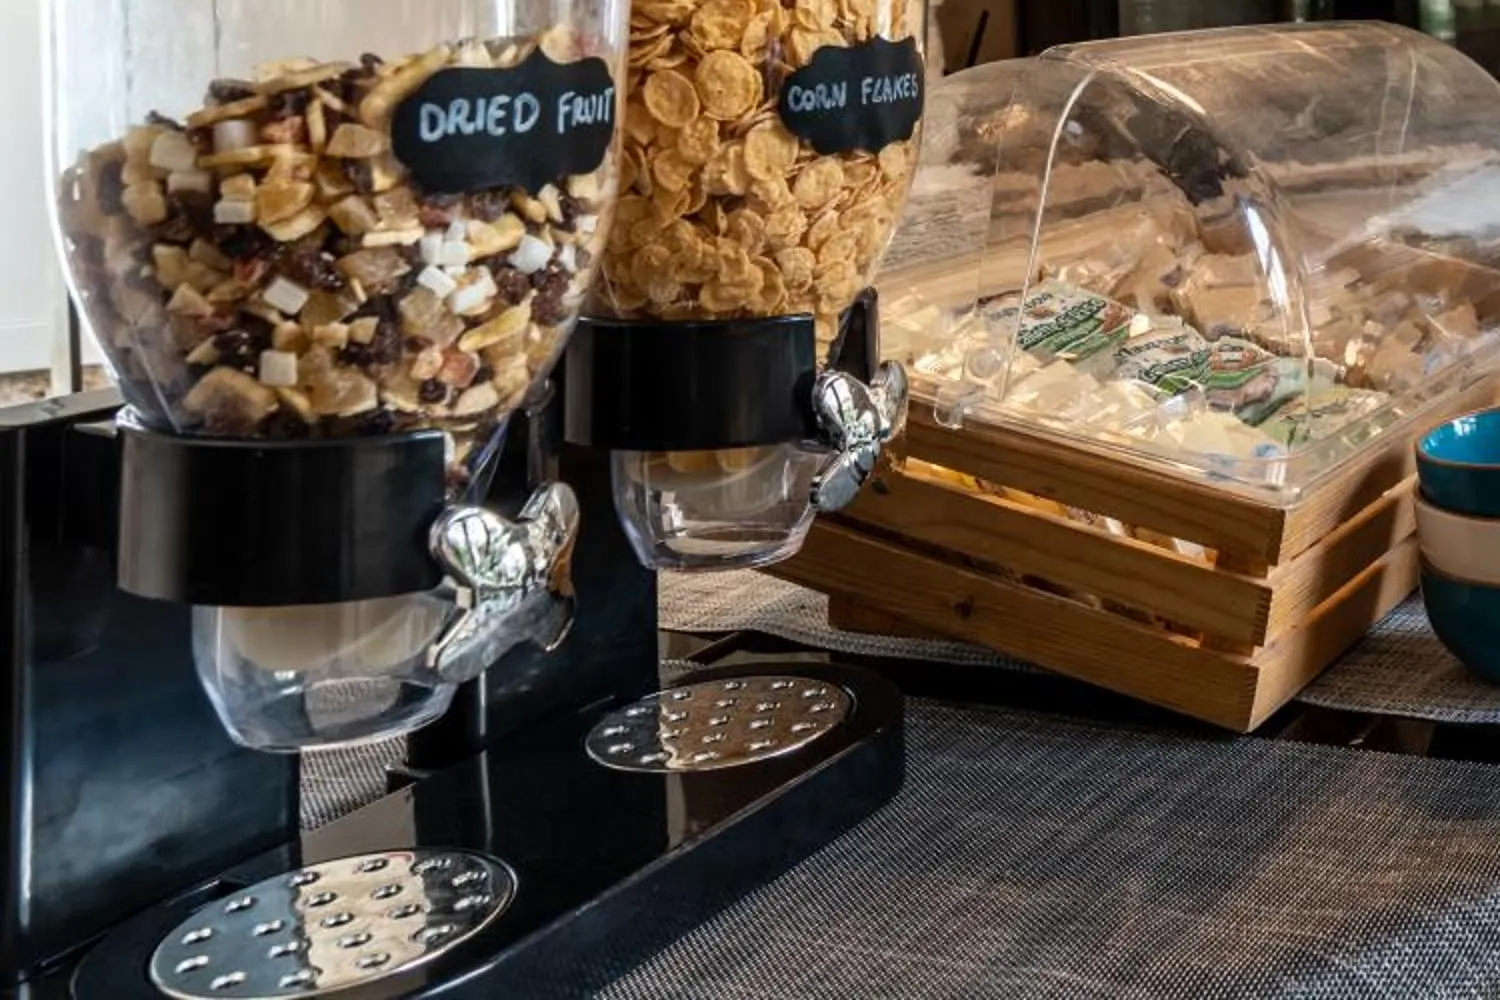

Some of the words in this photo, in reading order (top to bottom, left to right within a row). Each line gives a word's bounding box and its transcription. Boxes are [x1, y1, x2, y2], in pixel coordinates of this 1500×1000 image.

[419, 91, 541, 142] DRIED
[556, 87, 615, 135] FRUIT
[787, 81, 847, 112] CORN
[861, 72, 919, 105] FLAKES
